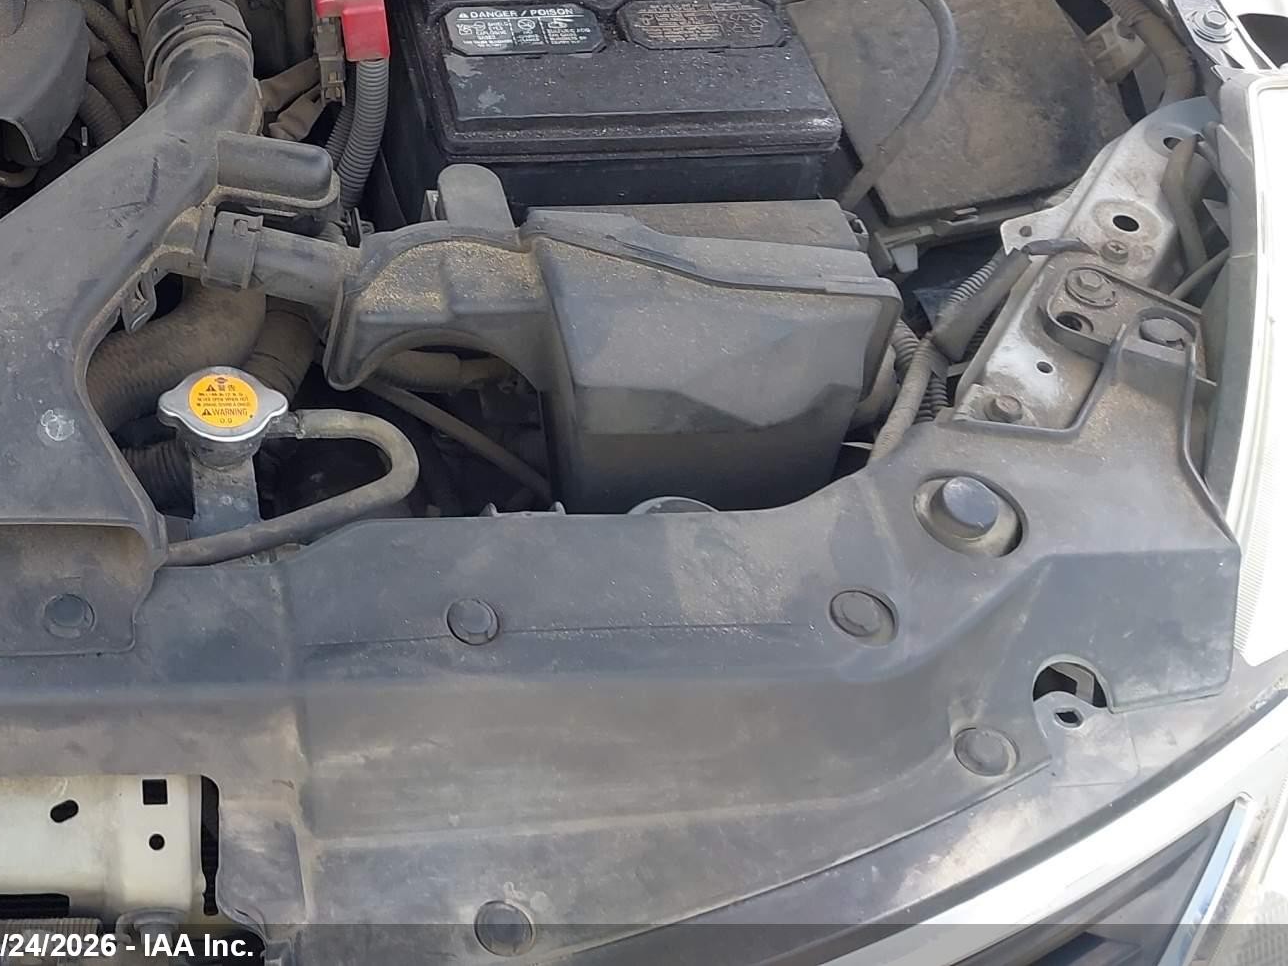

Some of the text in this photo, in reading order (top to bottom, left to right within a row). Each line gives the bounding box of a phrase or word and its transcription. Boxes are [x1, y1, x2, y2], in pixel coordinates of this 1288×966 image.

[470, 10, 518, 18] DANGER
[529, 8, 574, 16] POISON
[212, 408, 248, 416] WARNING
